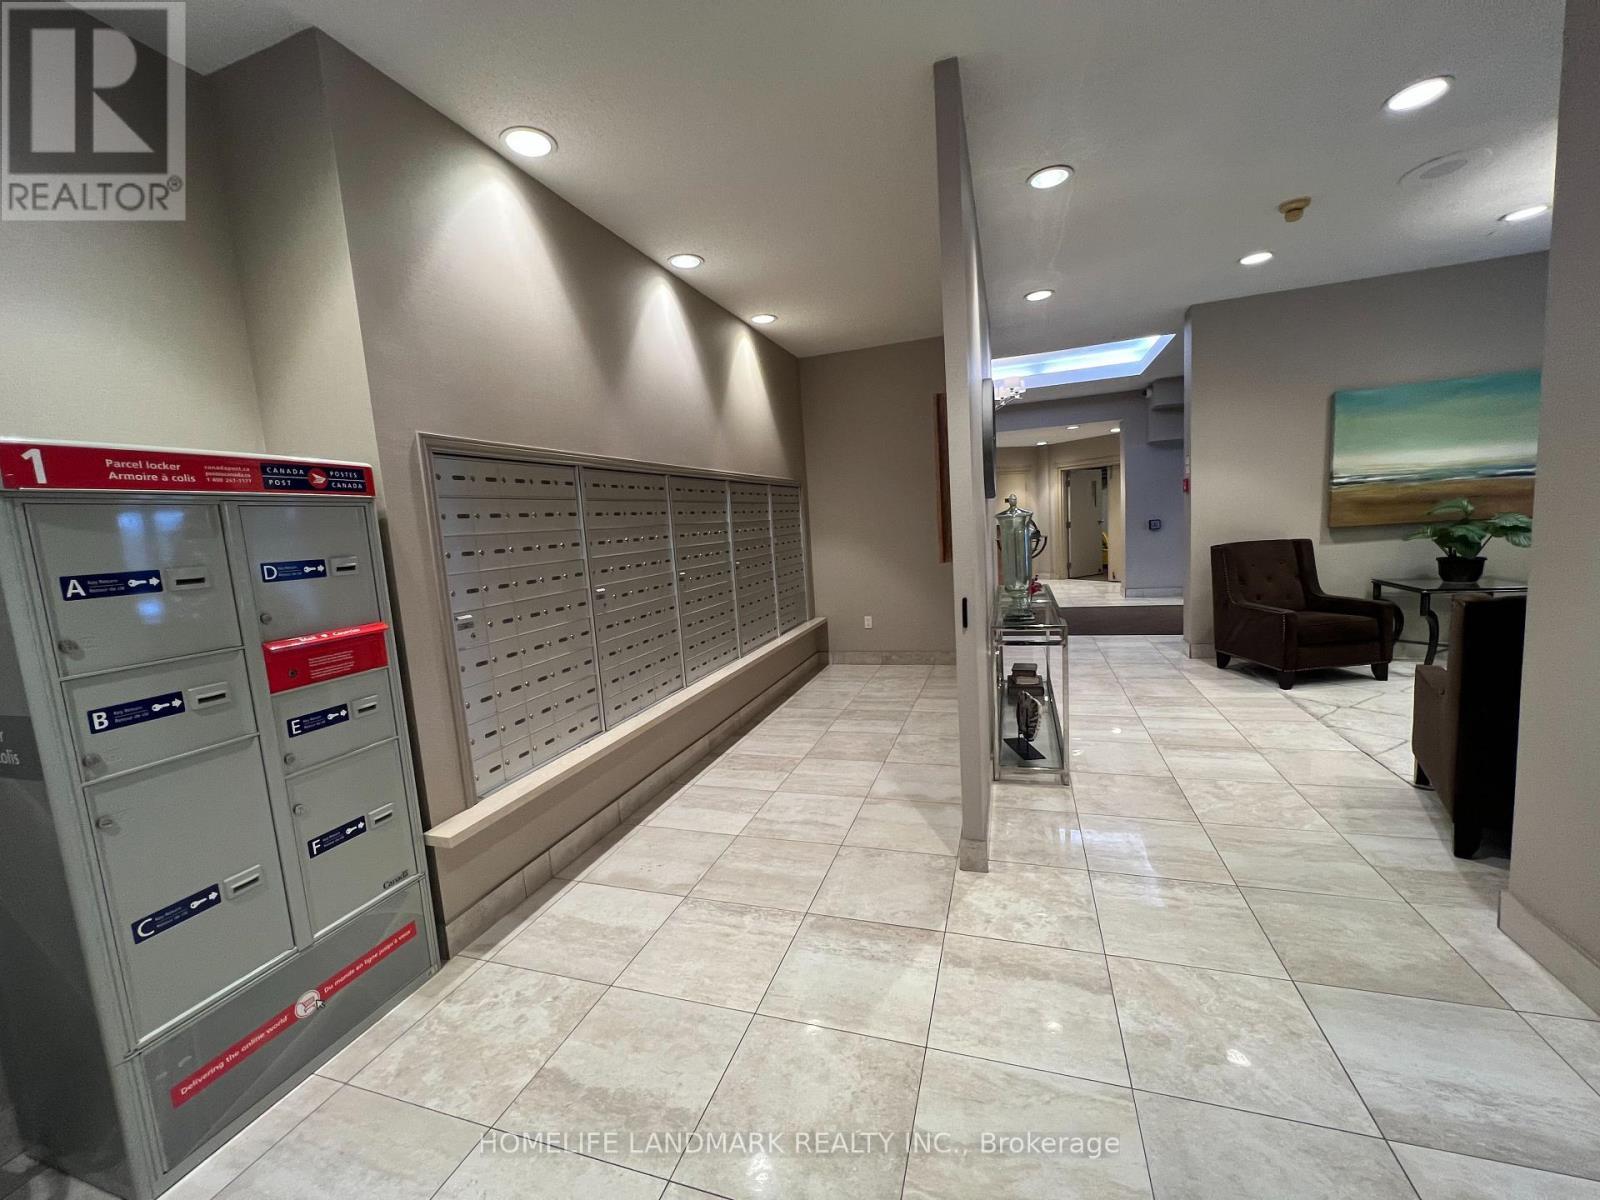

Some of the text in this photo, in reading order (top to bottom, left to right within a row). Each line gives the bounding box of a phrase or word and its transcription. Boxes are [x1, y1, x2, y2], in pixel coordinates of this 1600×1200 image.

[21, 448, 47, 484] 1
[105, 459, 181, 470] Parcel locker
[266, 467, 305, 475] CANADA
[109, 472, 196, 483] Armoire à colis
[330, 471, 358, 479] POSTES
[331, 481, 363, 489] CANADA
[263, 565, 278, 580] D
[67, 579, 86, 598] A
[92, 712, 109, 730] B
[291, 720, 302, 734] E
[312, 839, 320, 854] F
[137, 918, 155, 937] C
[324, 985, 333, 993] Du
[335, 969, 355, 986] monde
[364, 953, 378, 965] ligne
[180, 1015, 288, 1095] Delivering the online world
